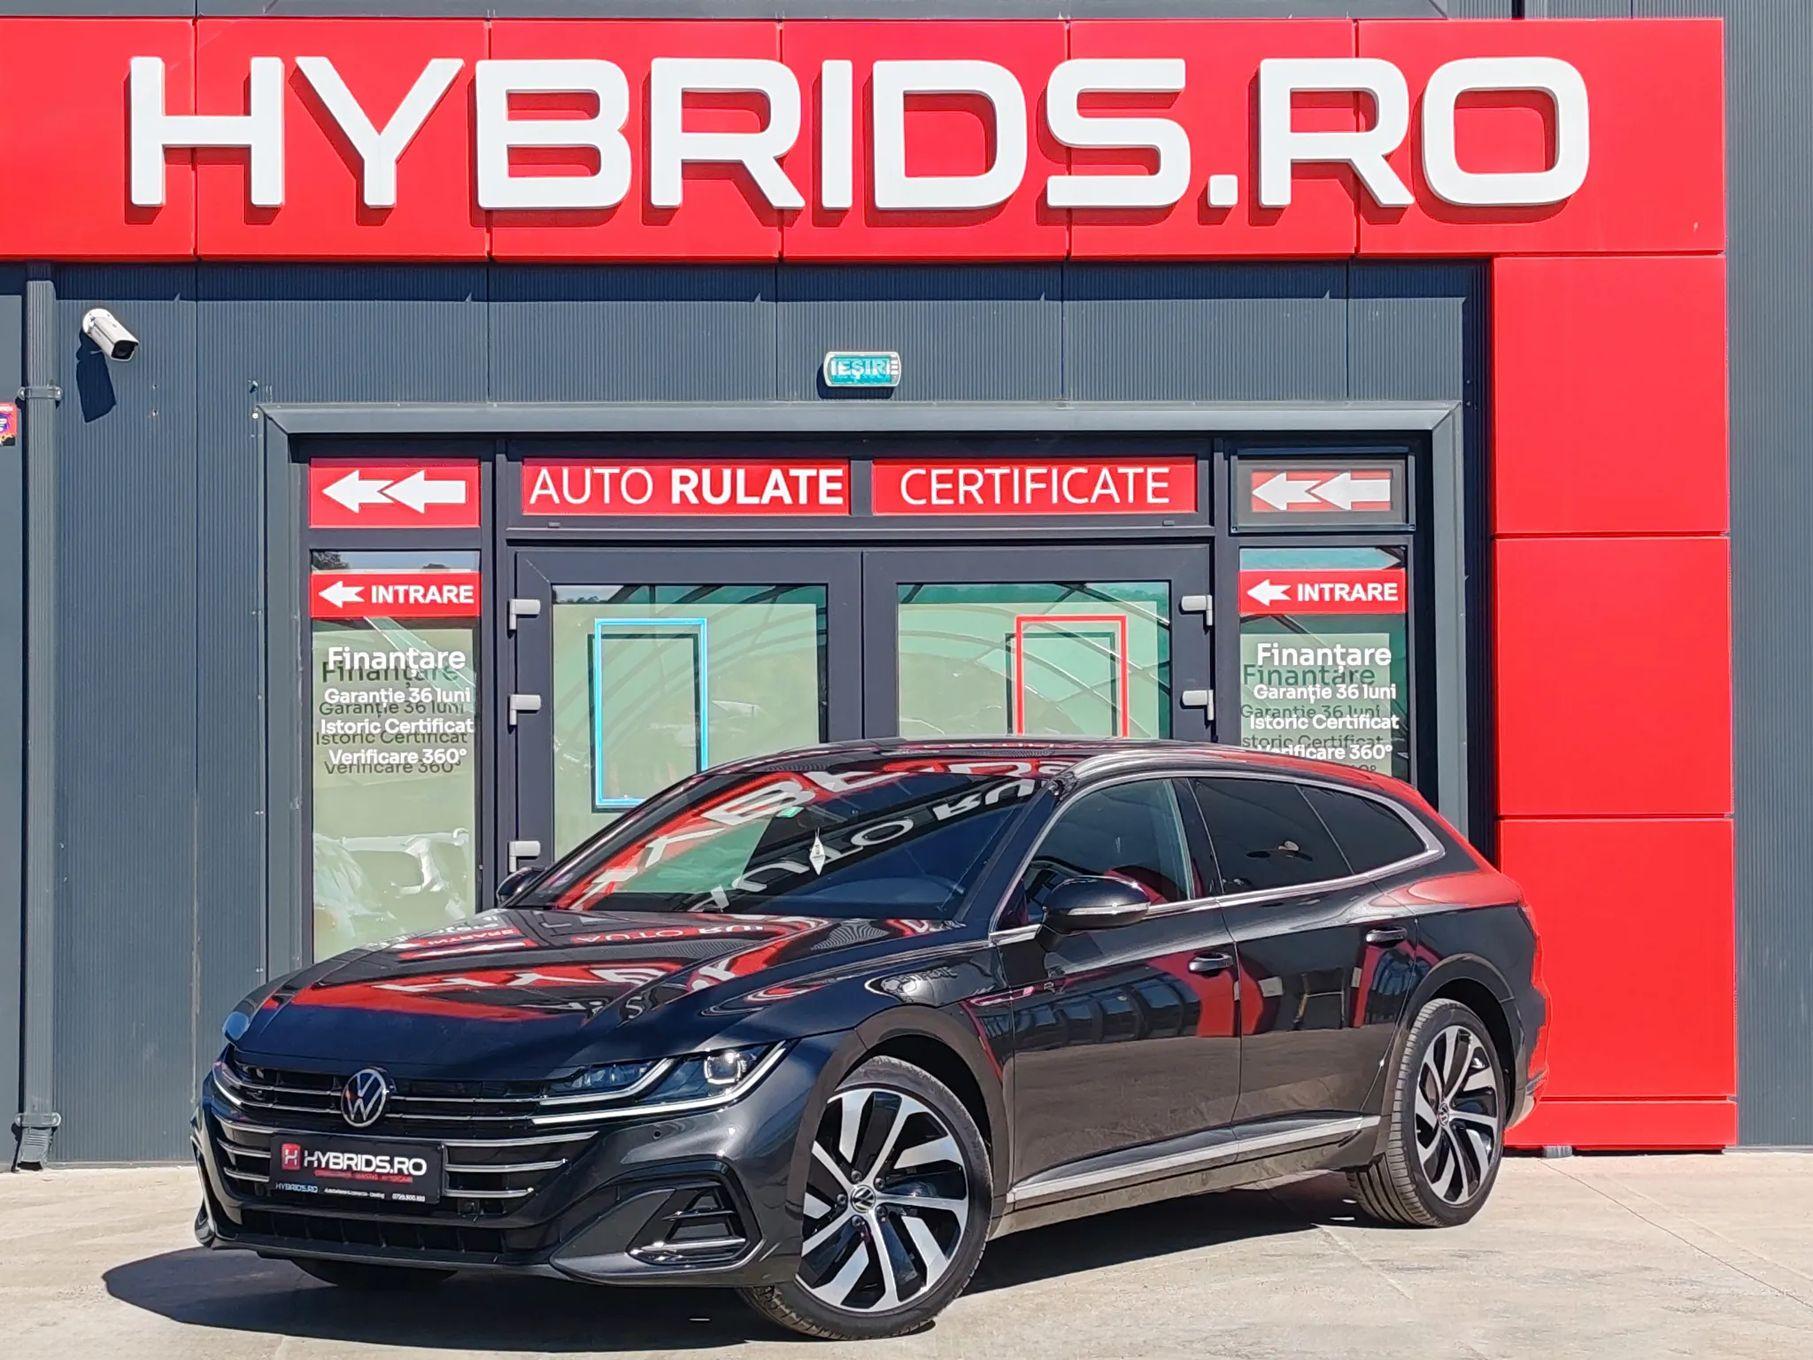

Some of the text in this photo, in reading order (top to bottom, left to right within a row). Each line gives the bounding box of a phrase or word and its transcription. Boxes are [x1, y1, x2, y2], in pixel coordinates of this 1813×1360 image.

[131, 55, 1590, 210] HYBRIDS.RO
[529, 467, 844, 505] AUTO RULATE
[900, 467, 1170, 505] CERTIFICATE
[371, 585, 474, 604] INTRARE
[1297, 582, 1398, 602] INTRARE
[328, 646, 466, 678] Finanțare
[1257, 643, 1392, 674] Finanțare
[324, 687, 471, 708] Garanție 36 luni
[1253, 684, 1397, 704] Garanție 36 luni
[321, 718, 475, 735] Istoric Certificat
[1250, 714, 1400, 730] Istoric Certificat
[328, 749, 419, 766] Verificare
[304, 1150, 427, 1176] HYBRIDS.RO
